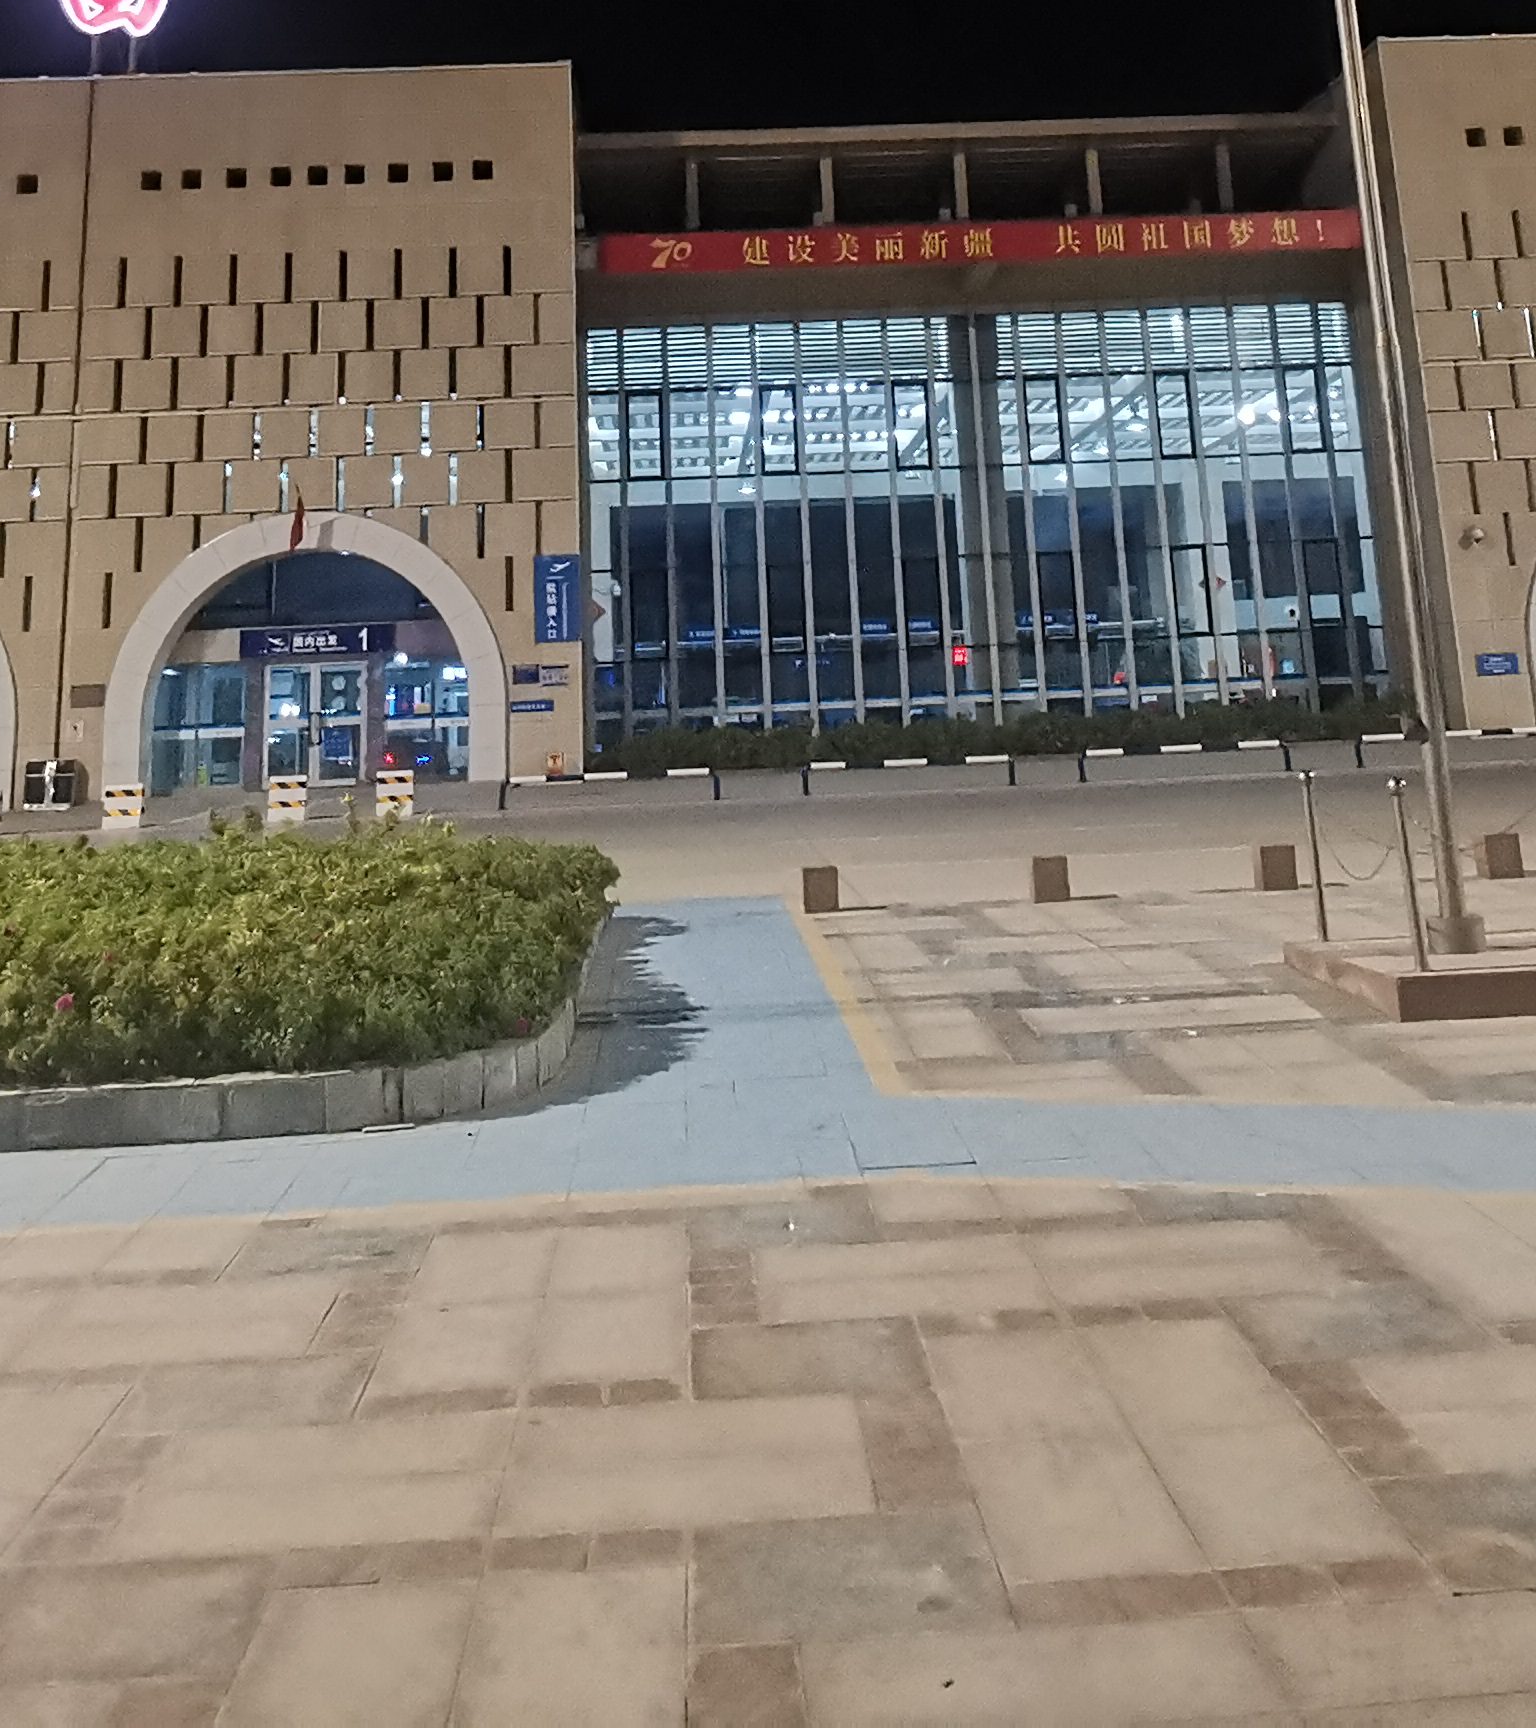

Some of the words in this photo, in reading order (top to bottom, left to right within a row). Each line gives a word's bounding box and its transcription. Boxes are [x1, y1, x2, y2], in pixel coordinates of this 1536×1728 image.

[649, 237, 693, 269] 70
[742, 227, 994, 266] 建设美丽新疆
[358, 627, 368, 651] 1
